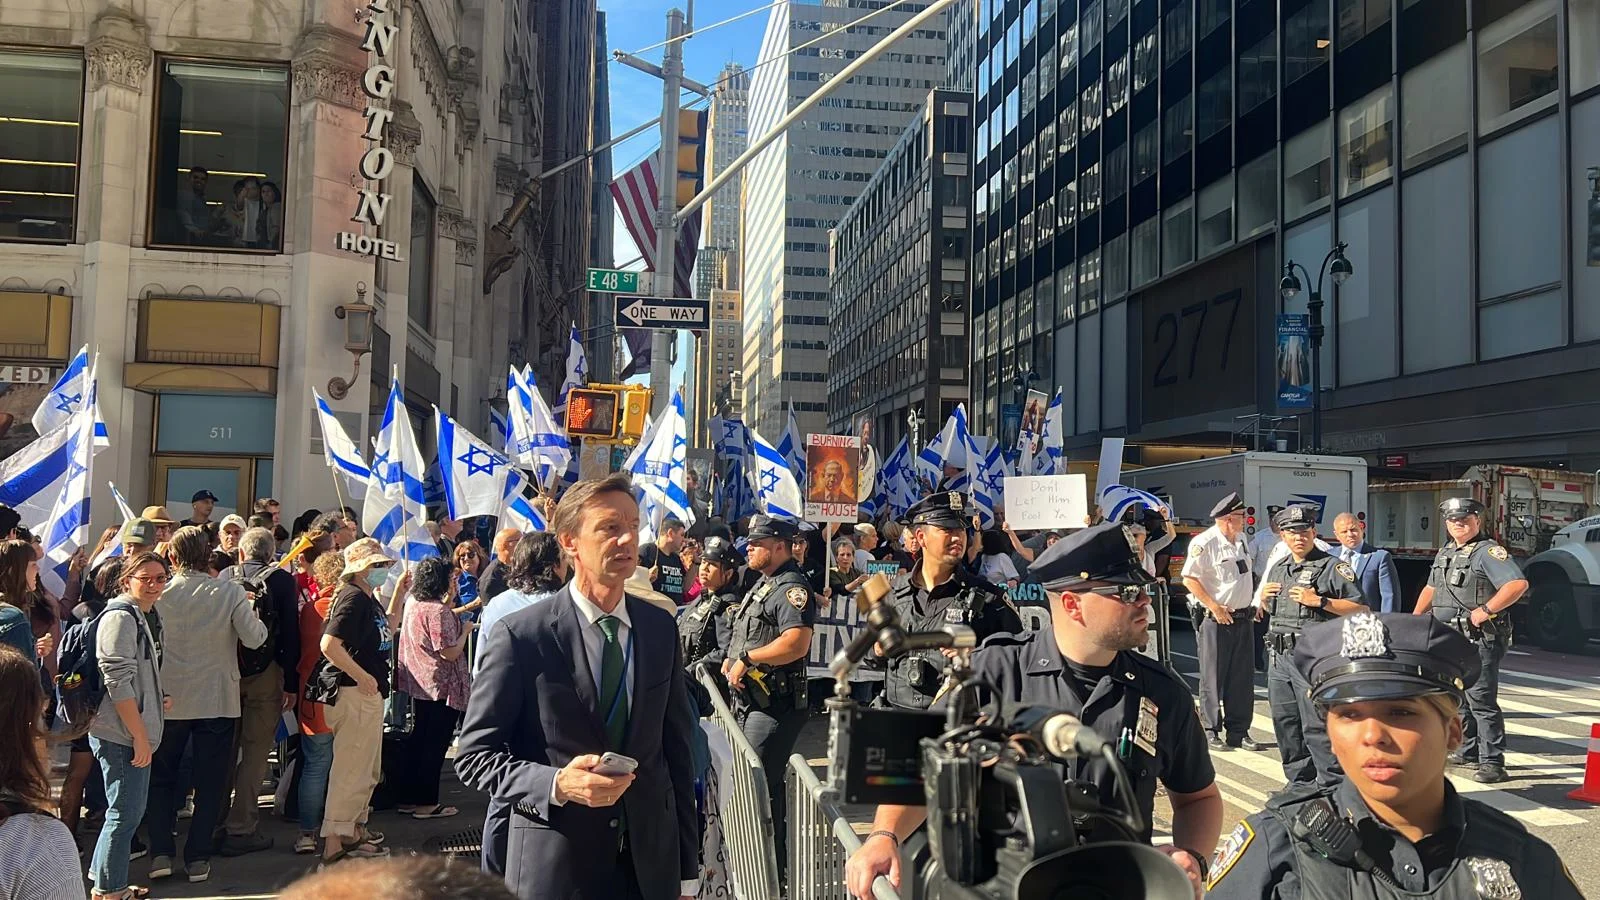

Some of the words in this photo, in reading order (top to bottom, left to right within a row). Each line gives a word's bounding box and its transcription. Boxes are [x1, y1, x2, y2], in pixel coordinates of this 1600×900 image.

[341, 231, 404, 261] HOTEL
[589, 271, 598, 289] E
[602, 272, 619, 290] 48
[623, 273, 635, 283] ST
[630, 306, 657, 319] ONE
[670, 308, 698, 320] WAY
[1153, 287, 1242, 387] 277
[209, 427, 232, 439] 511
[812, 434, 854, 448] BURNING
[1016, 496, 1036, 506] Let
[1048, 495, 1070, 504] Him
[821, 503, 857, 517] HOUSE
[867, 563, 900, 574] PROTECT
